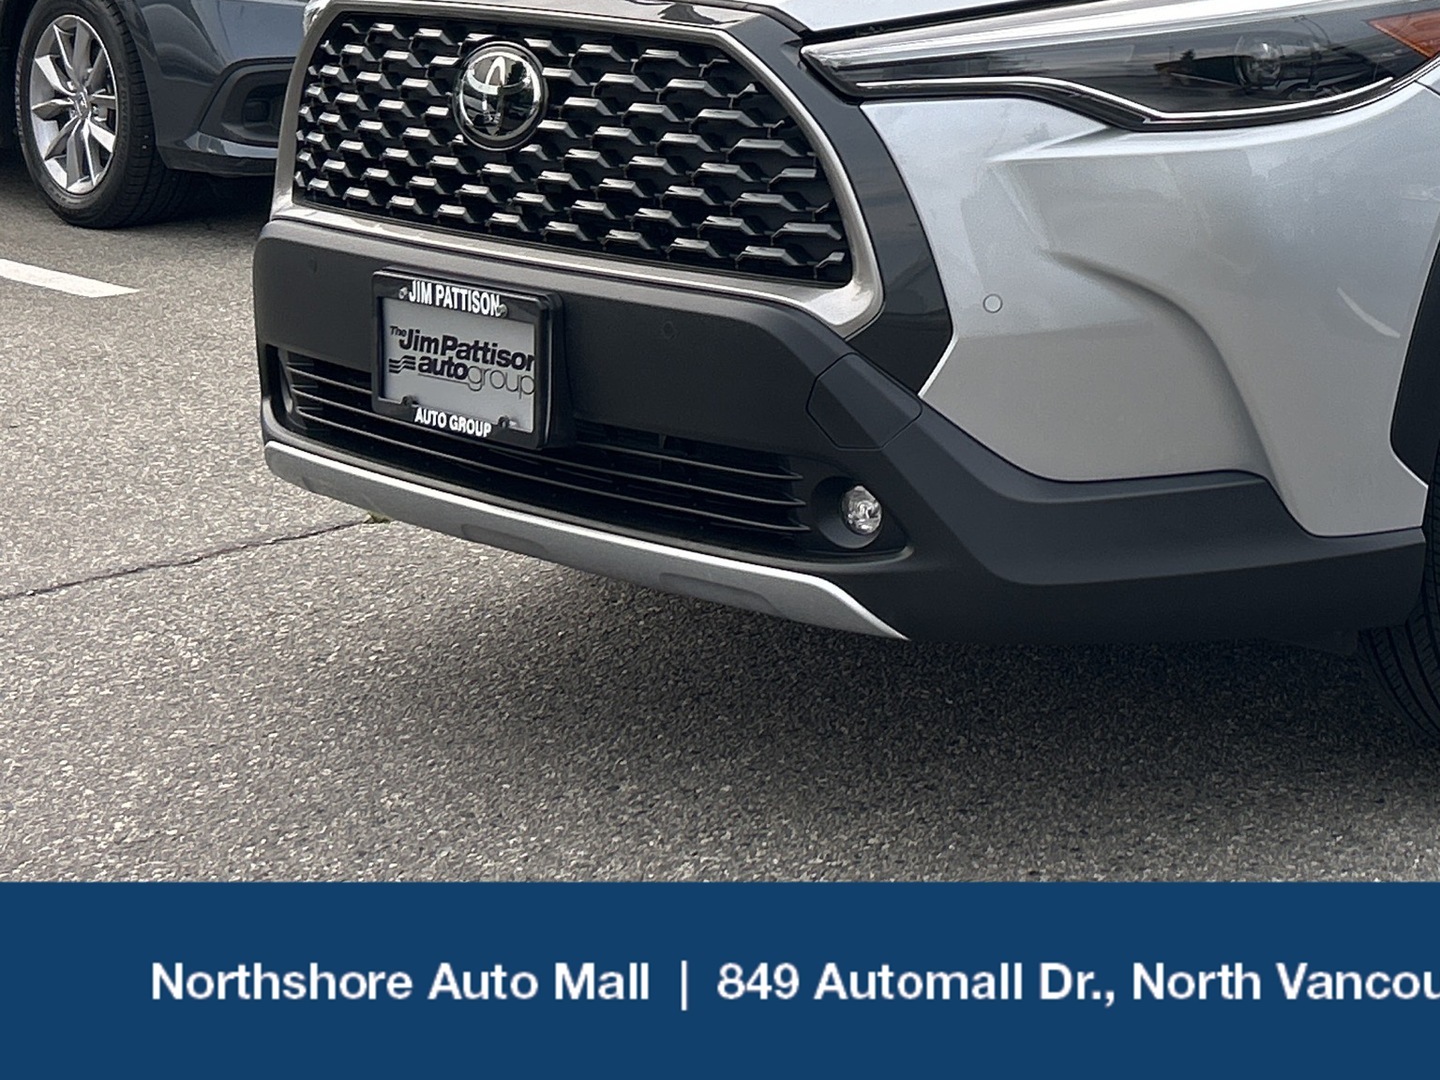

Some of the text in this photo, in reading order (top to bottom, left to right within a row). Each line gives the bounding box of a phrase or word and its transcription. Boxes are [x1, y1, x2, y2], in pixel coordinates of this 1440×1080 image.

[408, 280, 502, 317] JIM PATTISON
[390, 325, 407, 337] The
[414, 407, 493, 438] AUTO GROUP
